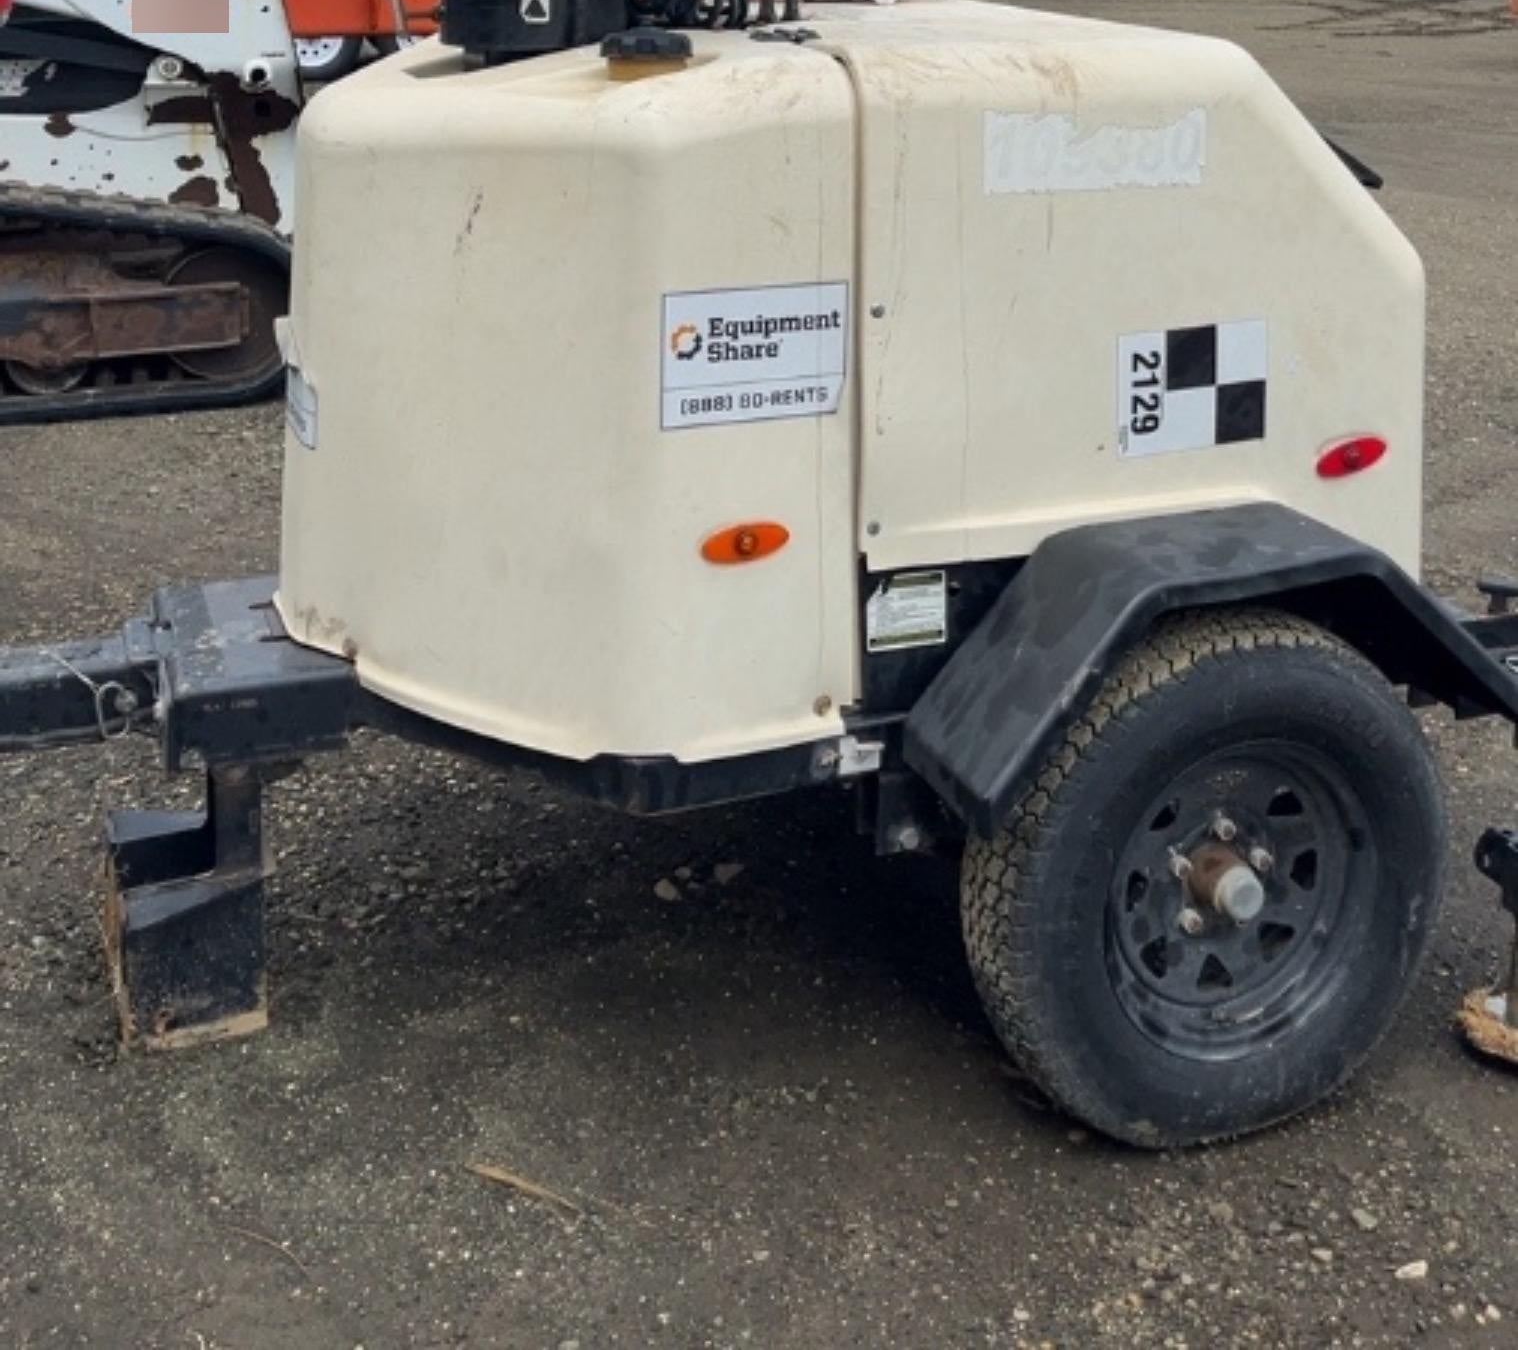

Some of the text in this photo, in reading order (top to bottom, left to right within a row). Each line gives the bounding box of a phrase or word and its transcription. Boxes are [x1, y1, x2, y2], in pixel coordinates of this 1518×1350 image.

[708, 309, 841, 340] Equipment
[707, 341, 779, 364] Share
[680, 393, 733, 416] (888)
[1130, 350, 1161, 435] 2129
